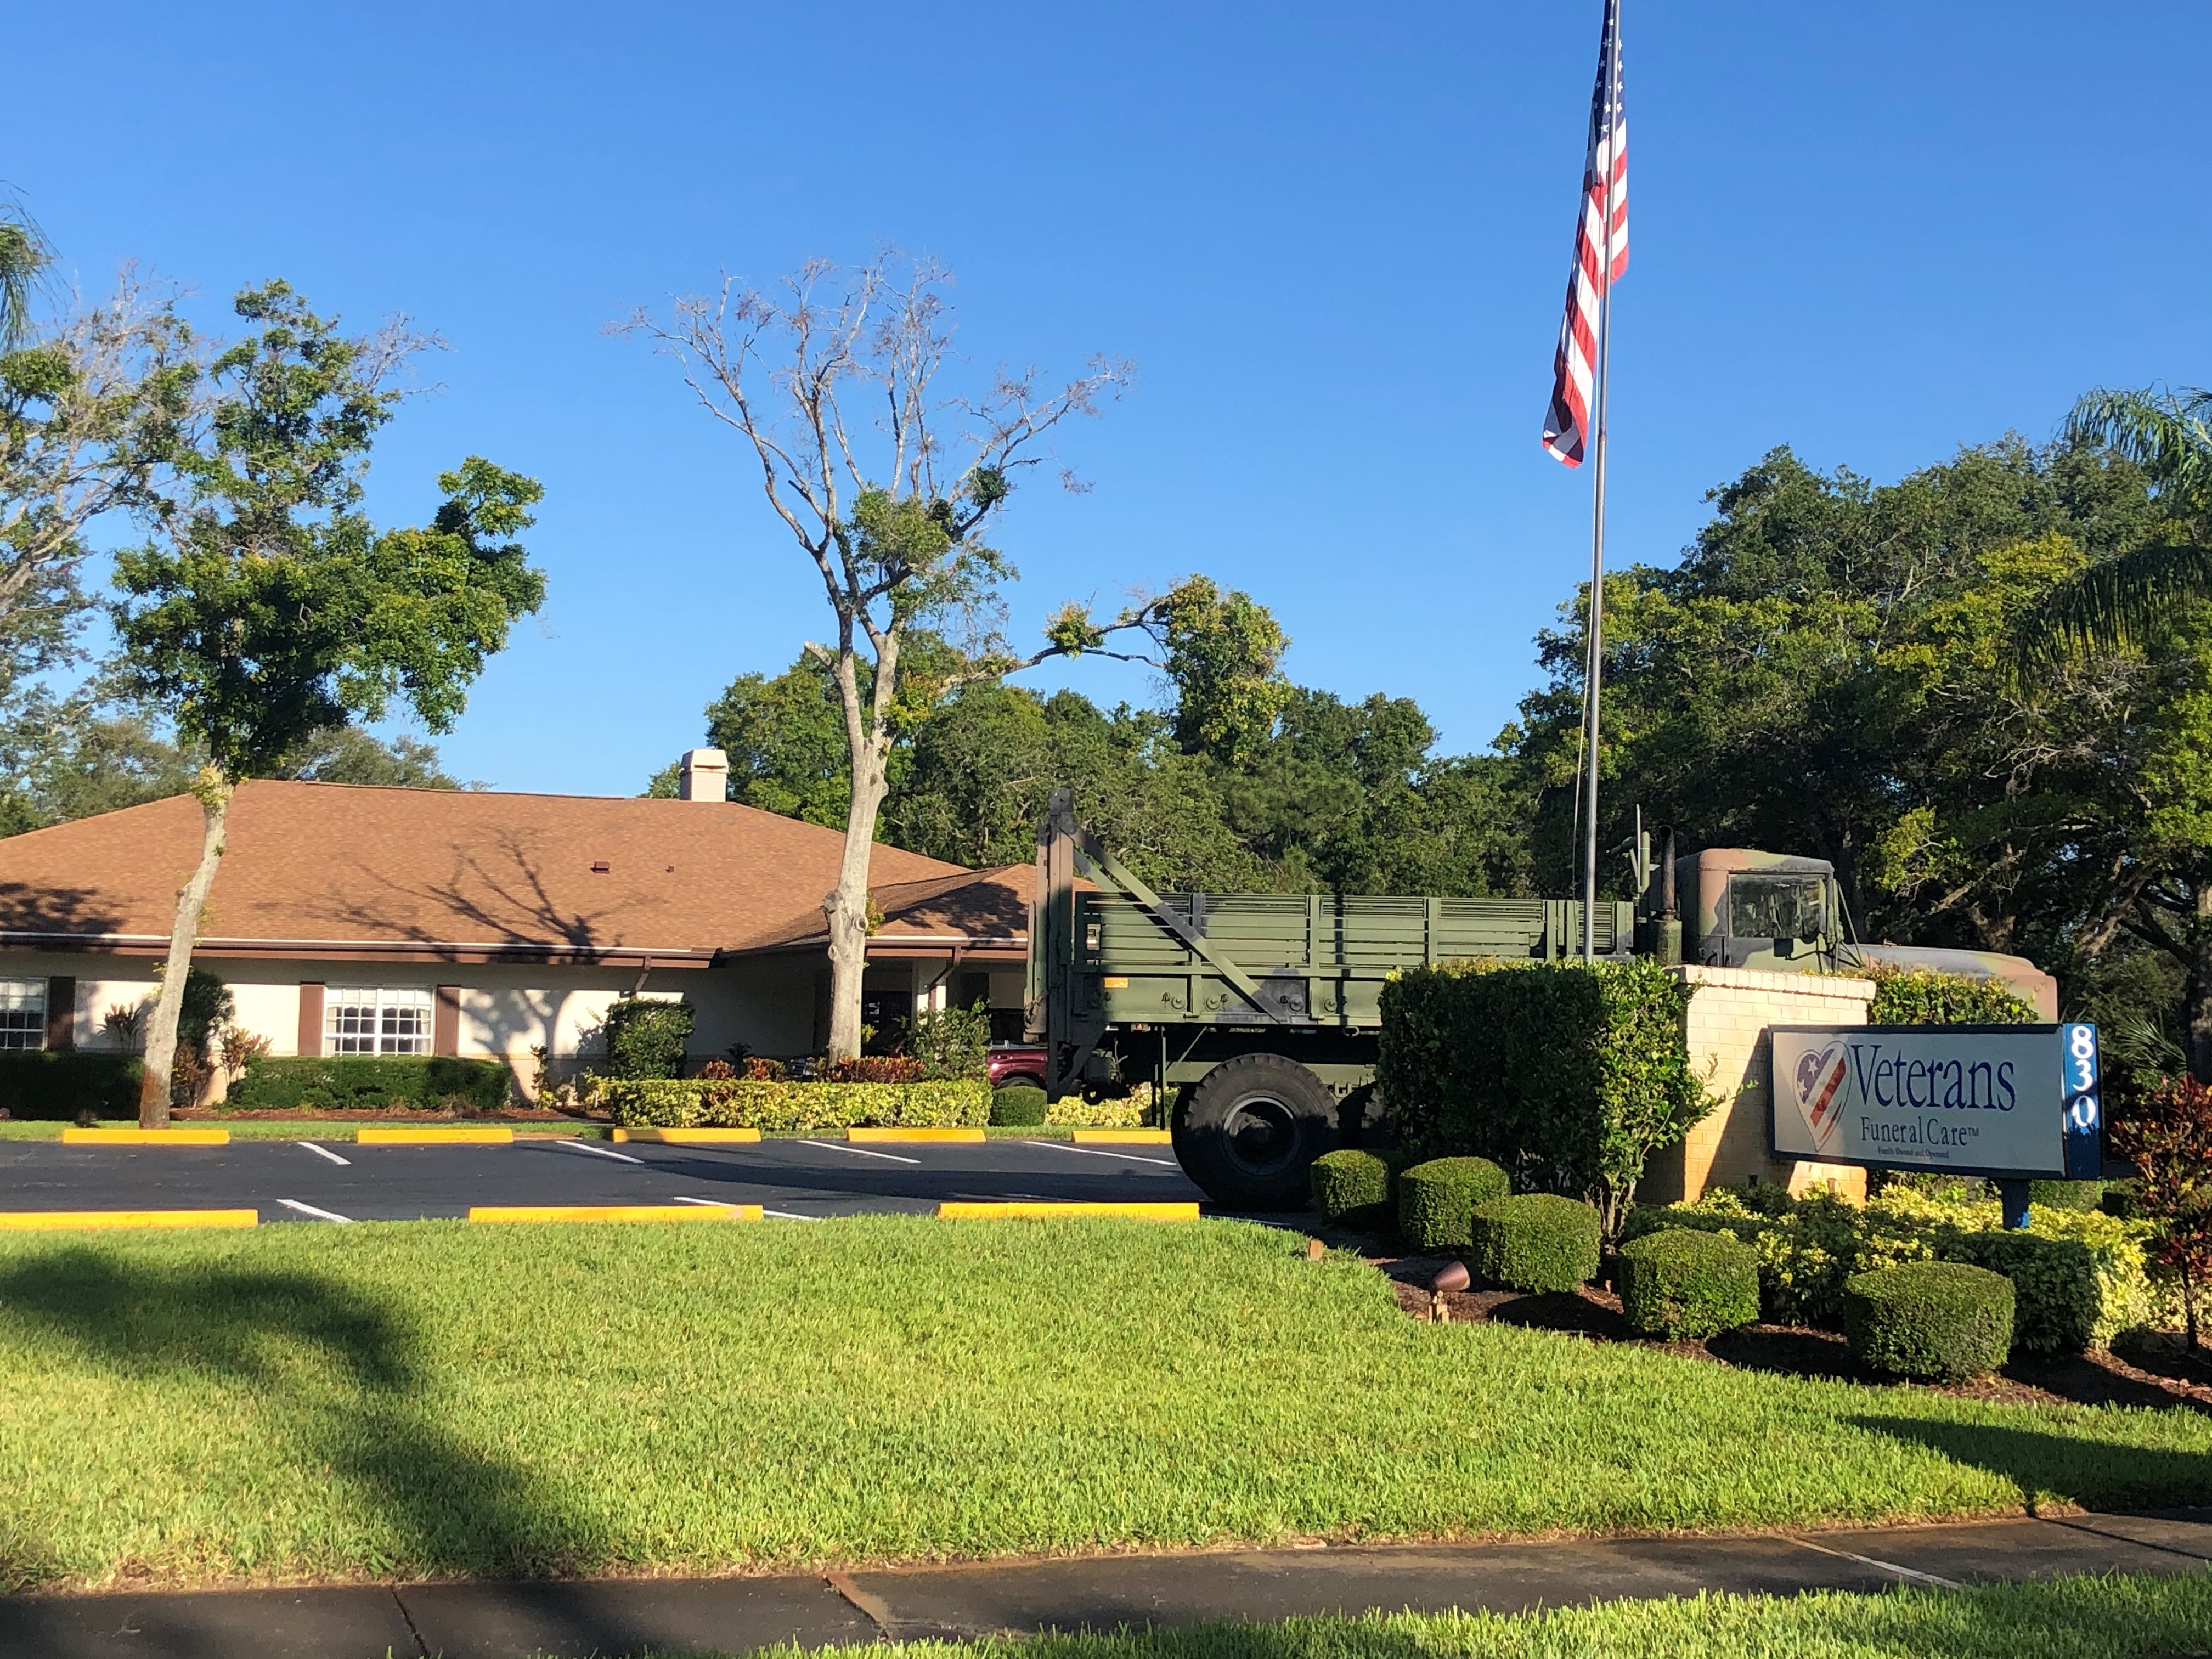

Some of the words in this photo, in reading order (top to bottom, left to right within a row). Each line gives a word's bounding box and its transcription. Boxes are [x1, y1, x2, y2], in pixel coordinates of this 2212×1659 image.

[1850, 1045, 2016, 1111] Veterans
[2070, 1025, 2096, 1127] 830
[1860, 1116, 1924, 1144] Funeral
